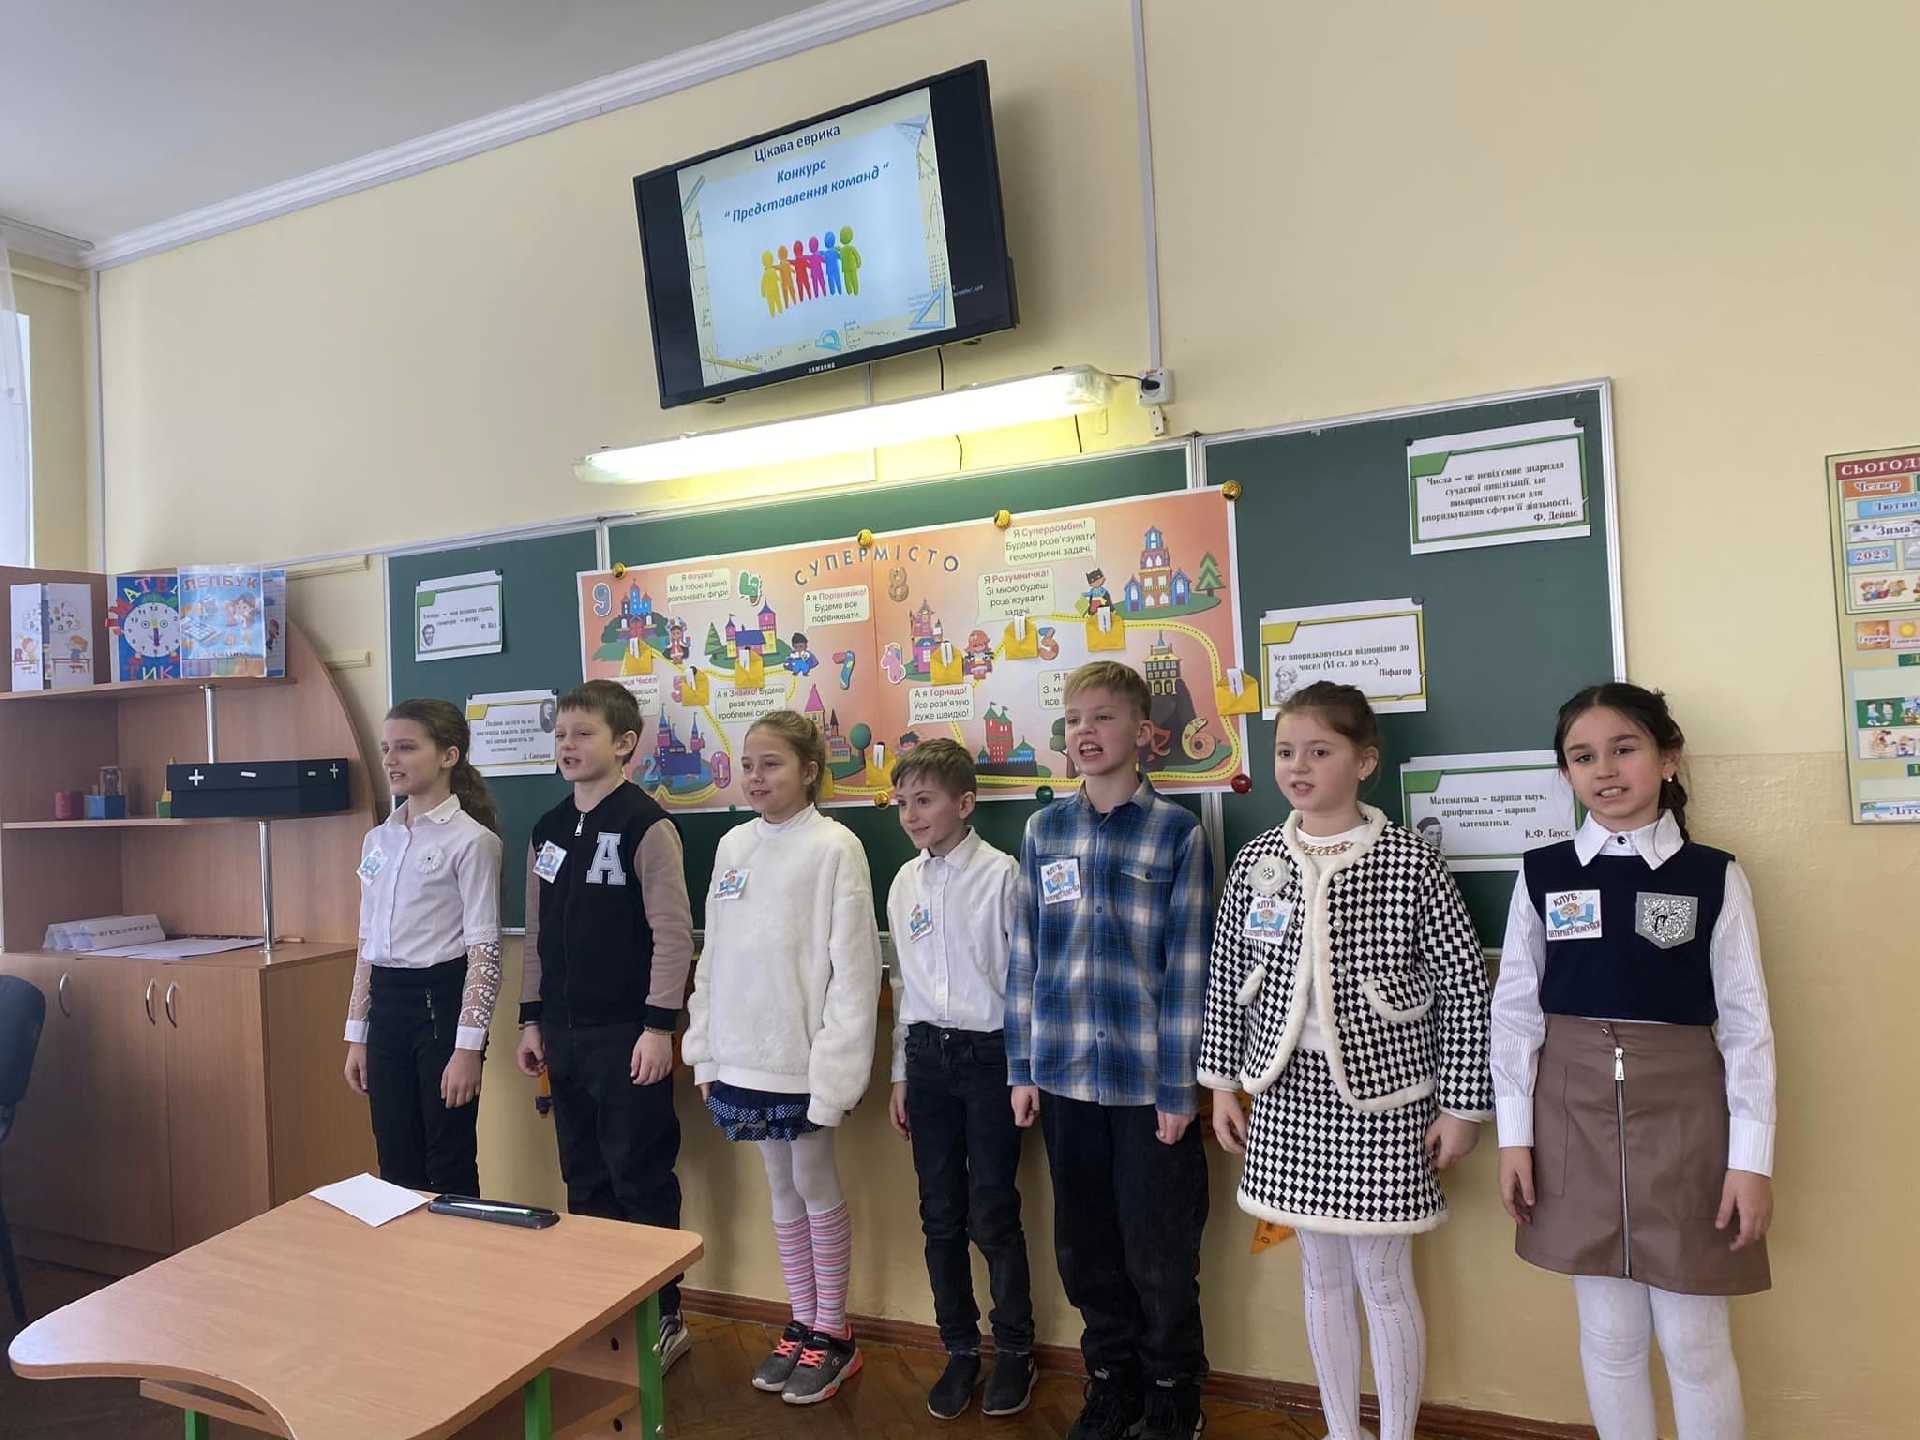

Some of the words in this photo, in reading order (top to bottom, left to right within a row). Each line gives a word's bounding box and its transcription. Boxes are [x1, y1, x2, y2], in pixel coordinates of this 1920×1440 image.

[754, 139, 794, 164] Цікава
[796, 124, 842, 150] еврика
[776, 159, 827, 184] Конкурс
[732, 183, 829, 224] Представлення
[831, 164, 881, 193] команд
[1841, 457, 1920, 476] СЬОГОД
[1426, 477, 1451, 486] Числа
[1445, 485, 1482, 497] сучасної
[1486, 504, 1515, 516] сфери
[1877, 526, 1911, 536] Зима
[794, 544, 960, 586] СУПЕРМІСТО
[936, 708, 969, 720] швидко!
[1429, 795, 1480, 805] Математика
[585, 831, 627, 886] A
[1552, 892, 1578, 907] КЛУБ
